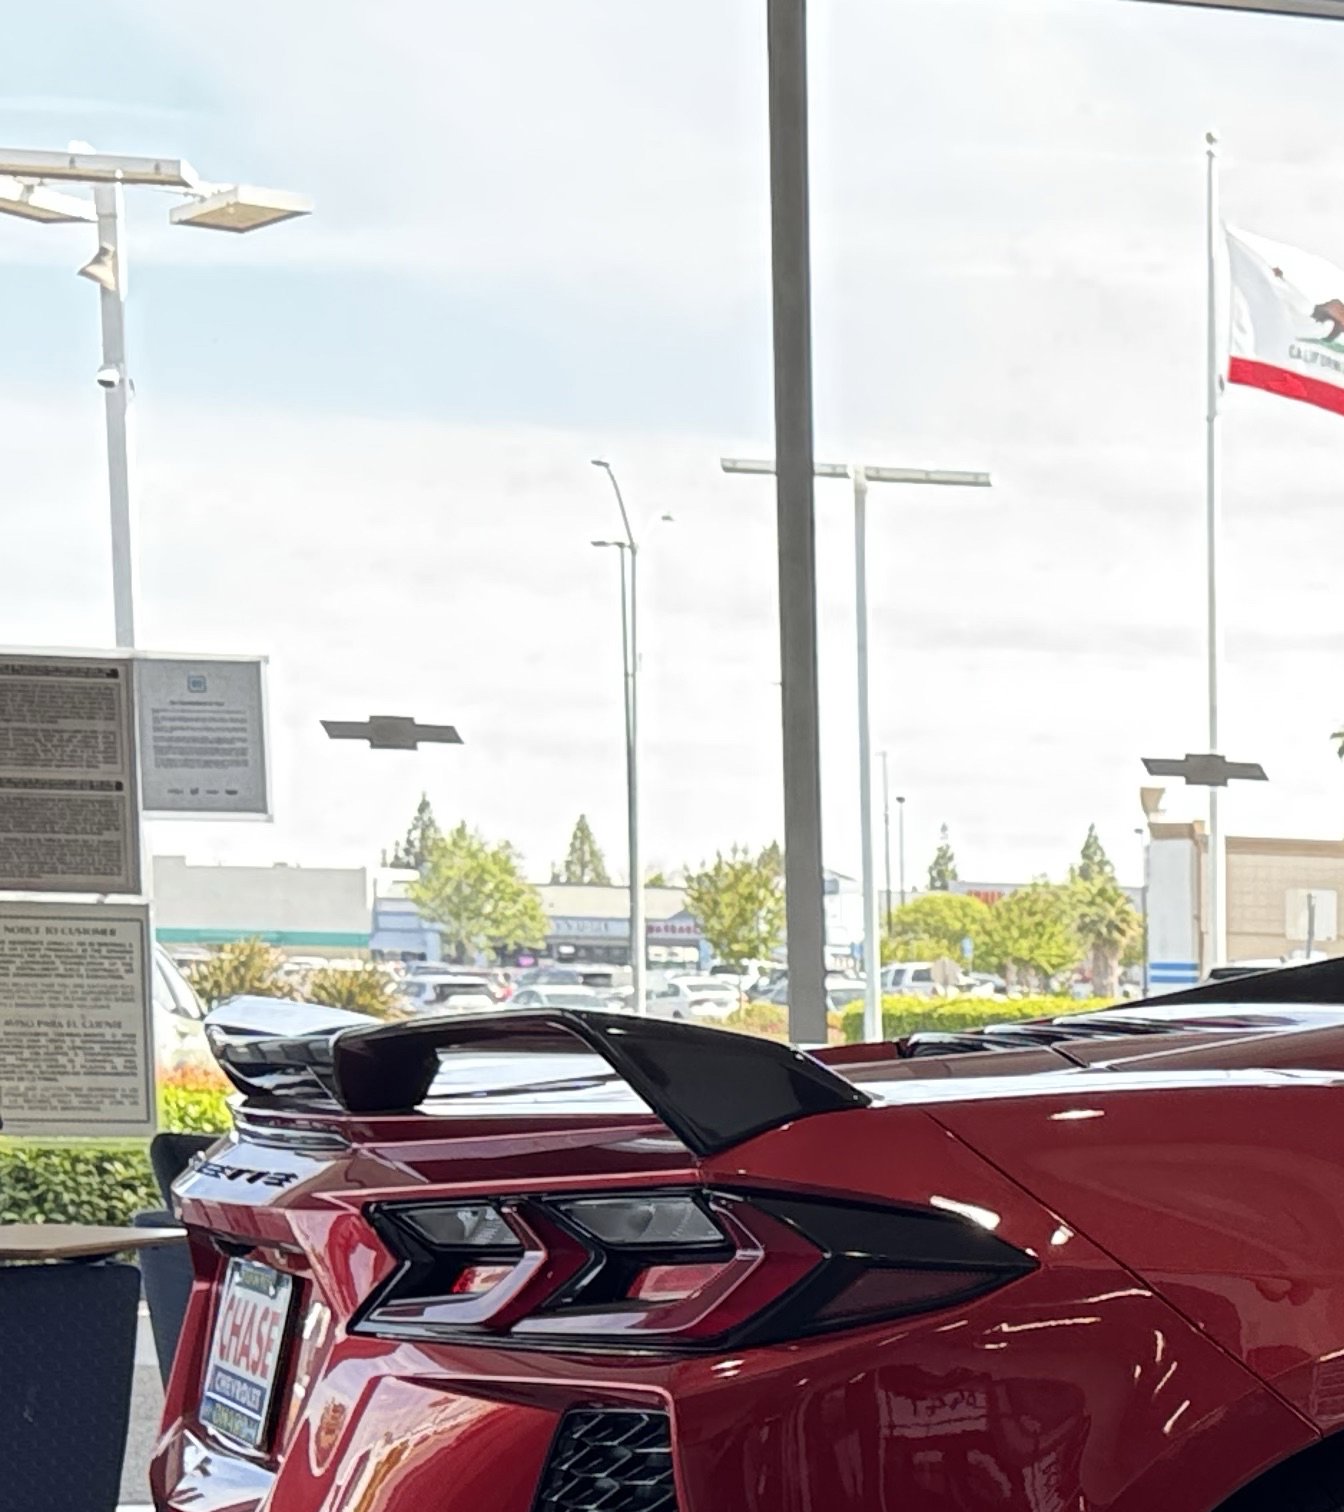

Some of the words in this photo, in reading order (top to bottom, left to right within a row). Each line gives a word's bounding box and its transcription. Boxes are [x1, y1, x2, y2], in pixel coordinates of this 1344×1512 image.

[62, 926, 117, 937] CUSTOMER
[218, 1296, 281, 1379] CHASE
[214, 1371, 262, 1411] CHEVROLET
